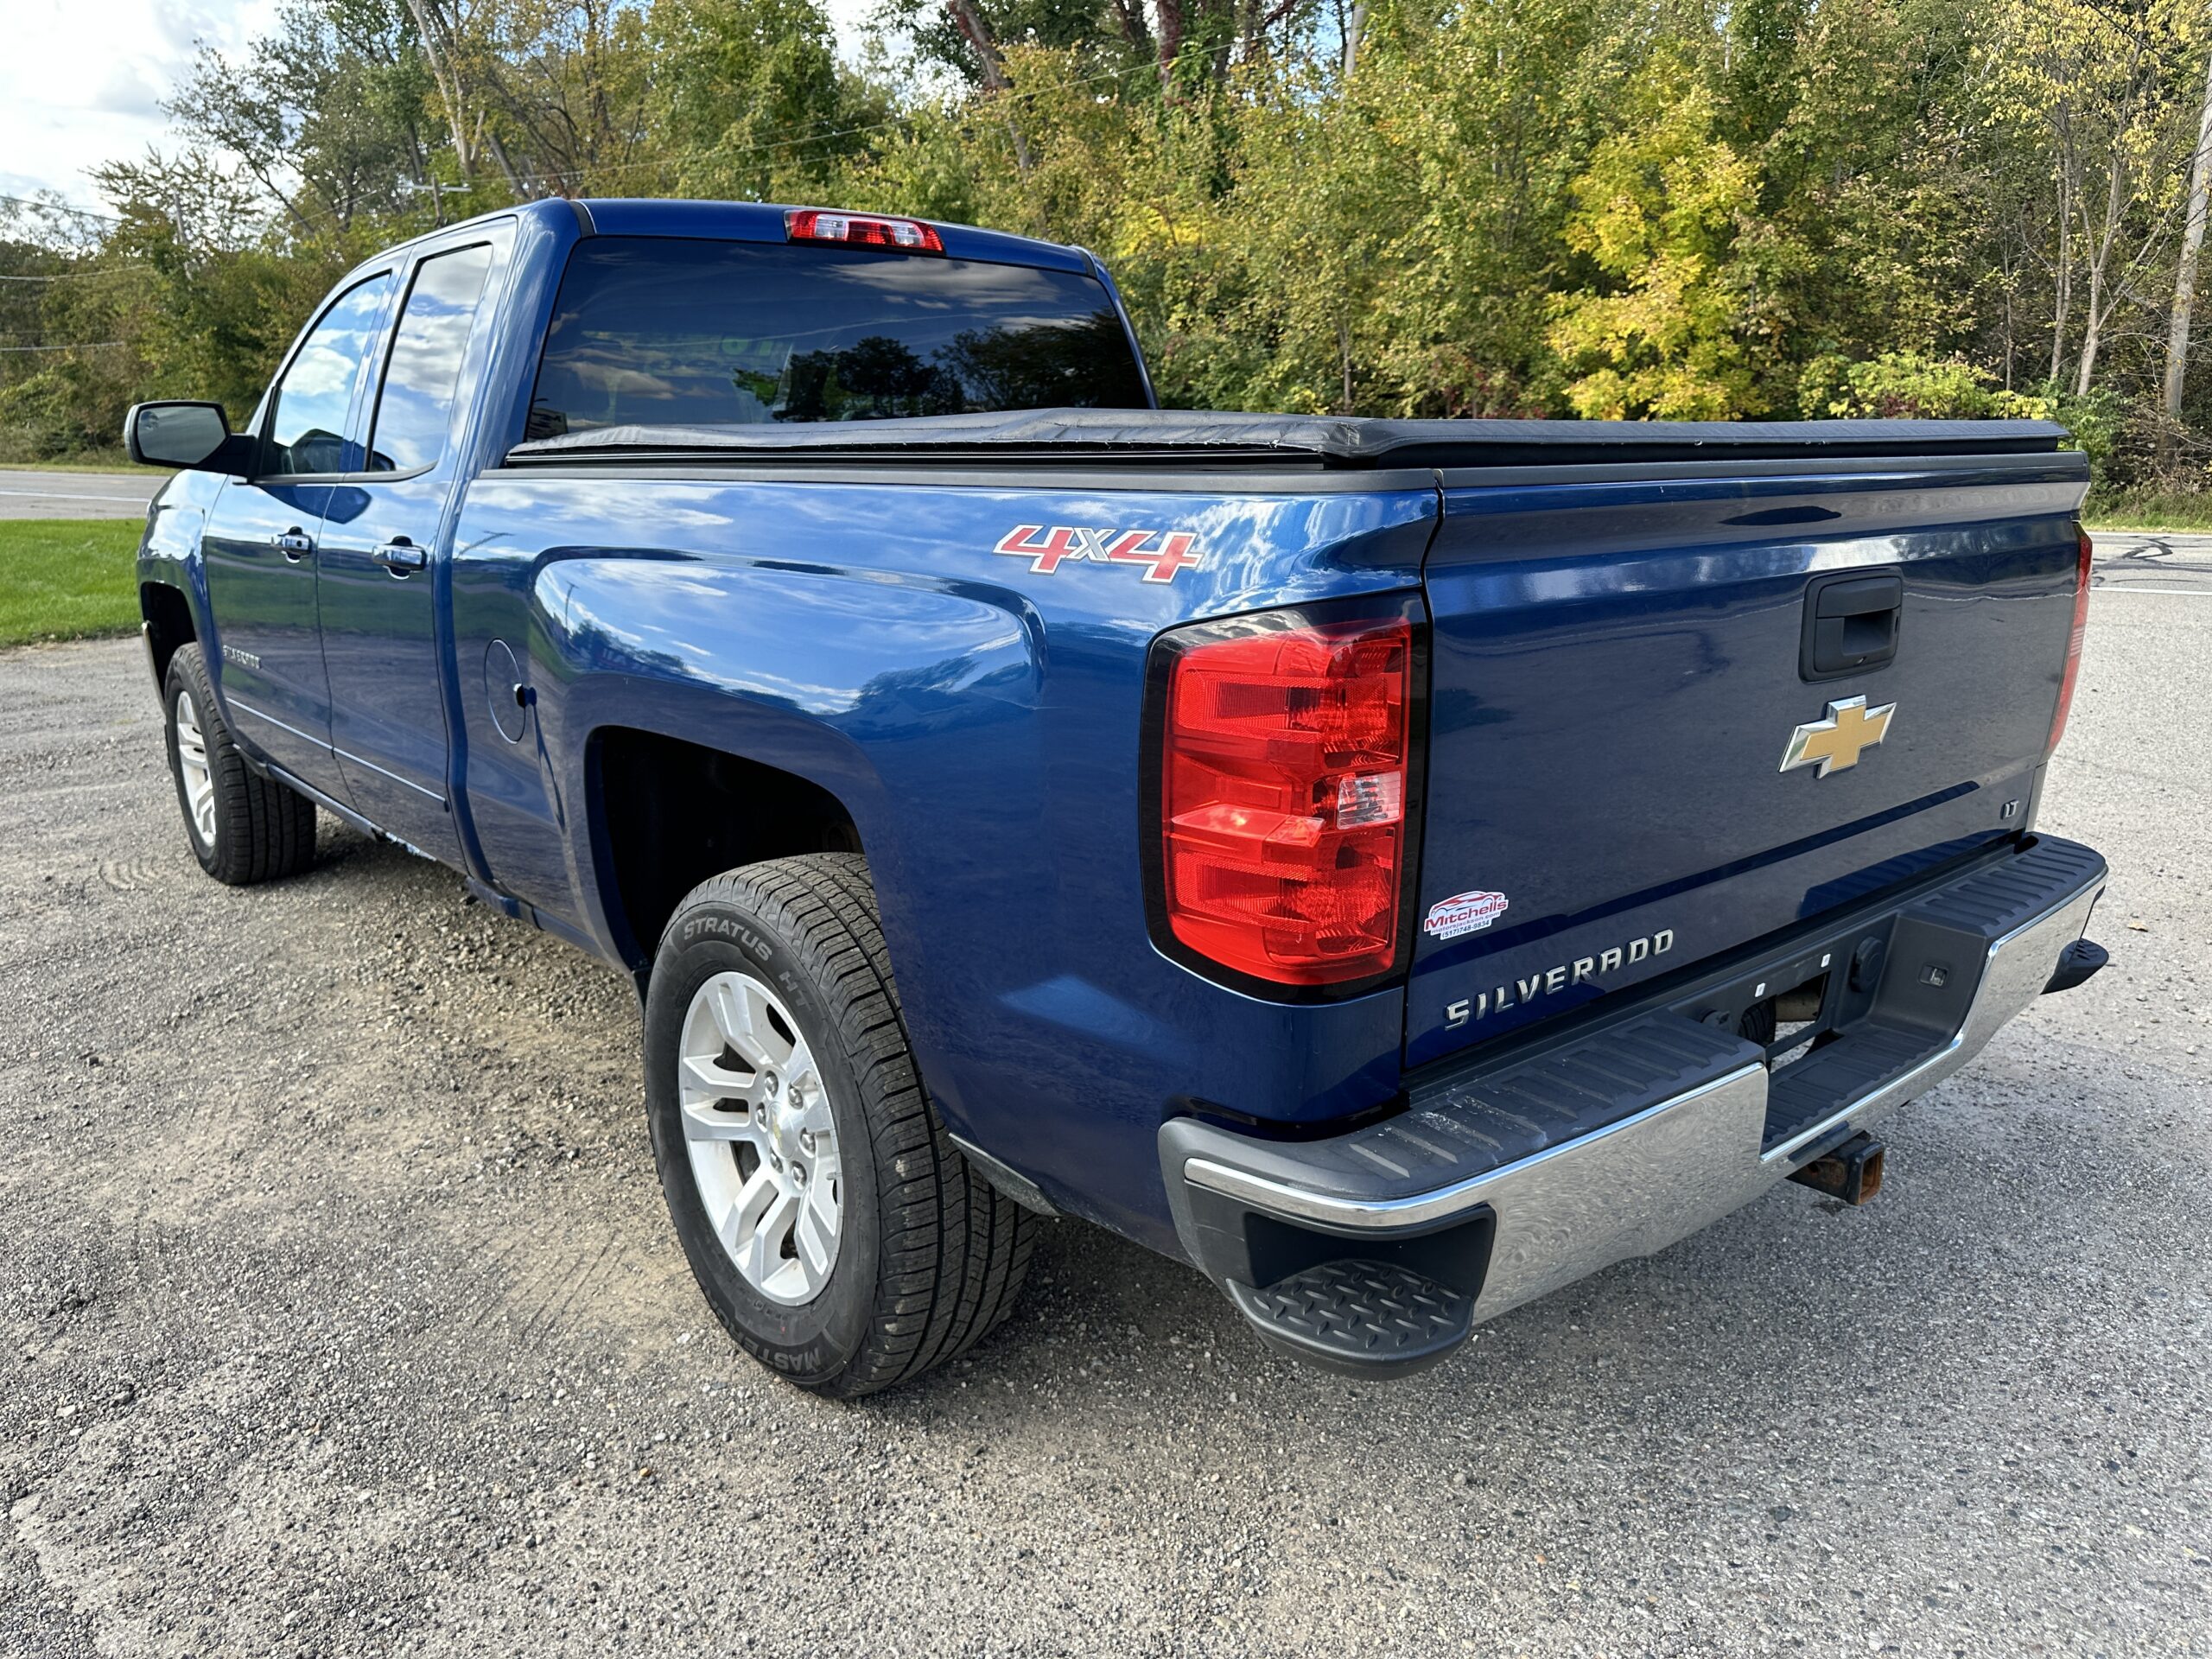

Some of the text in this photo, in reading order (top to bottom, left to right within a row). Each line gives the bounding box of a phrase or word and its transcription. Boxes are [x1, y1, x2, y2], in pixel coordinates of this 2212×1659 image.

[1425, 901, 1507, 930] Mitchells
[683, 916, 772, 962] STRATUS
[1444, 928, 1674, 1031] SILVERADO
